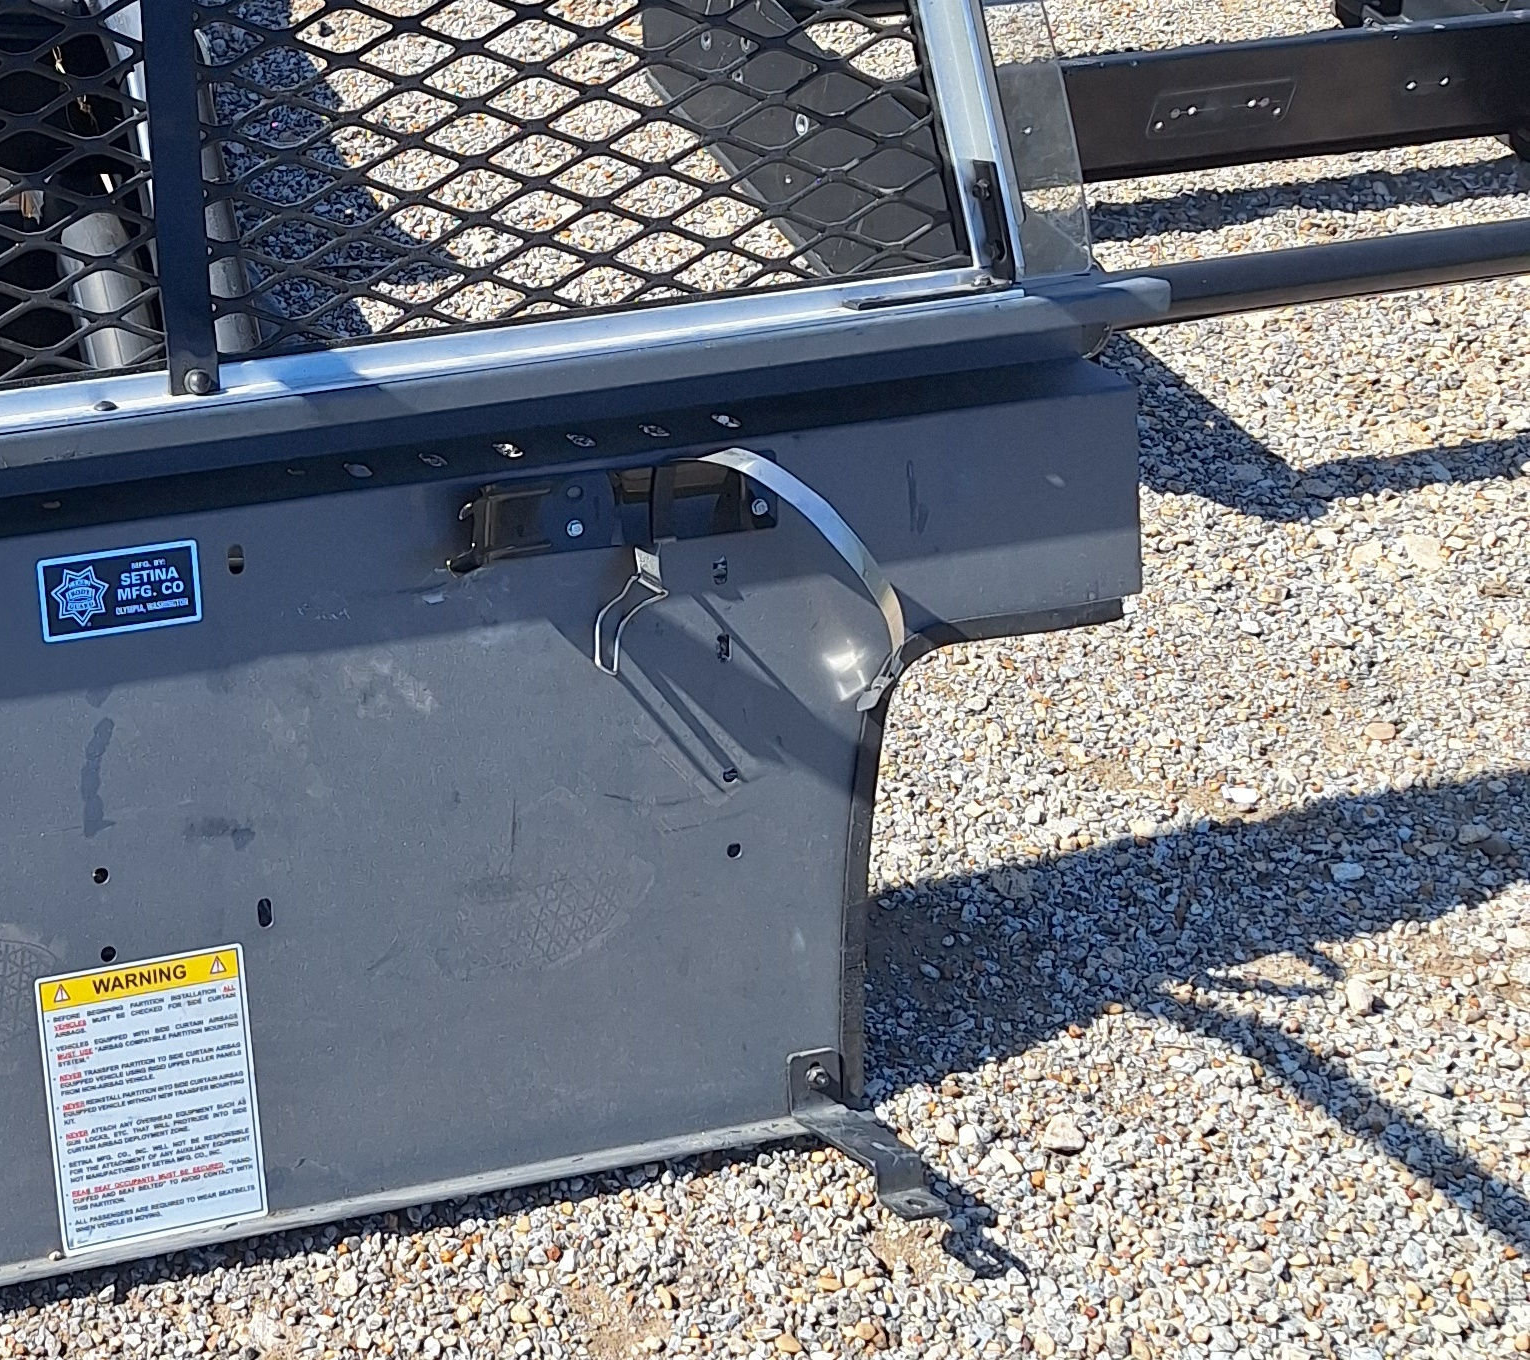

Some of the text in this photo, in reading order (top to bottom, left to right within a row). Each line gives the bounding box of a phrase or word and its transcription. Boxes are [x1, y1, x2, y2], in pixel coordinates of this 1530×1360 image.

[131, 561, 151, 570] MFG.
[120, 567, 179, 586] SETINA
[117, 580, 185, 601] MFG. CO
[92, 965, 187, 995] WARNING
